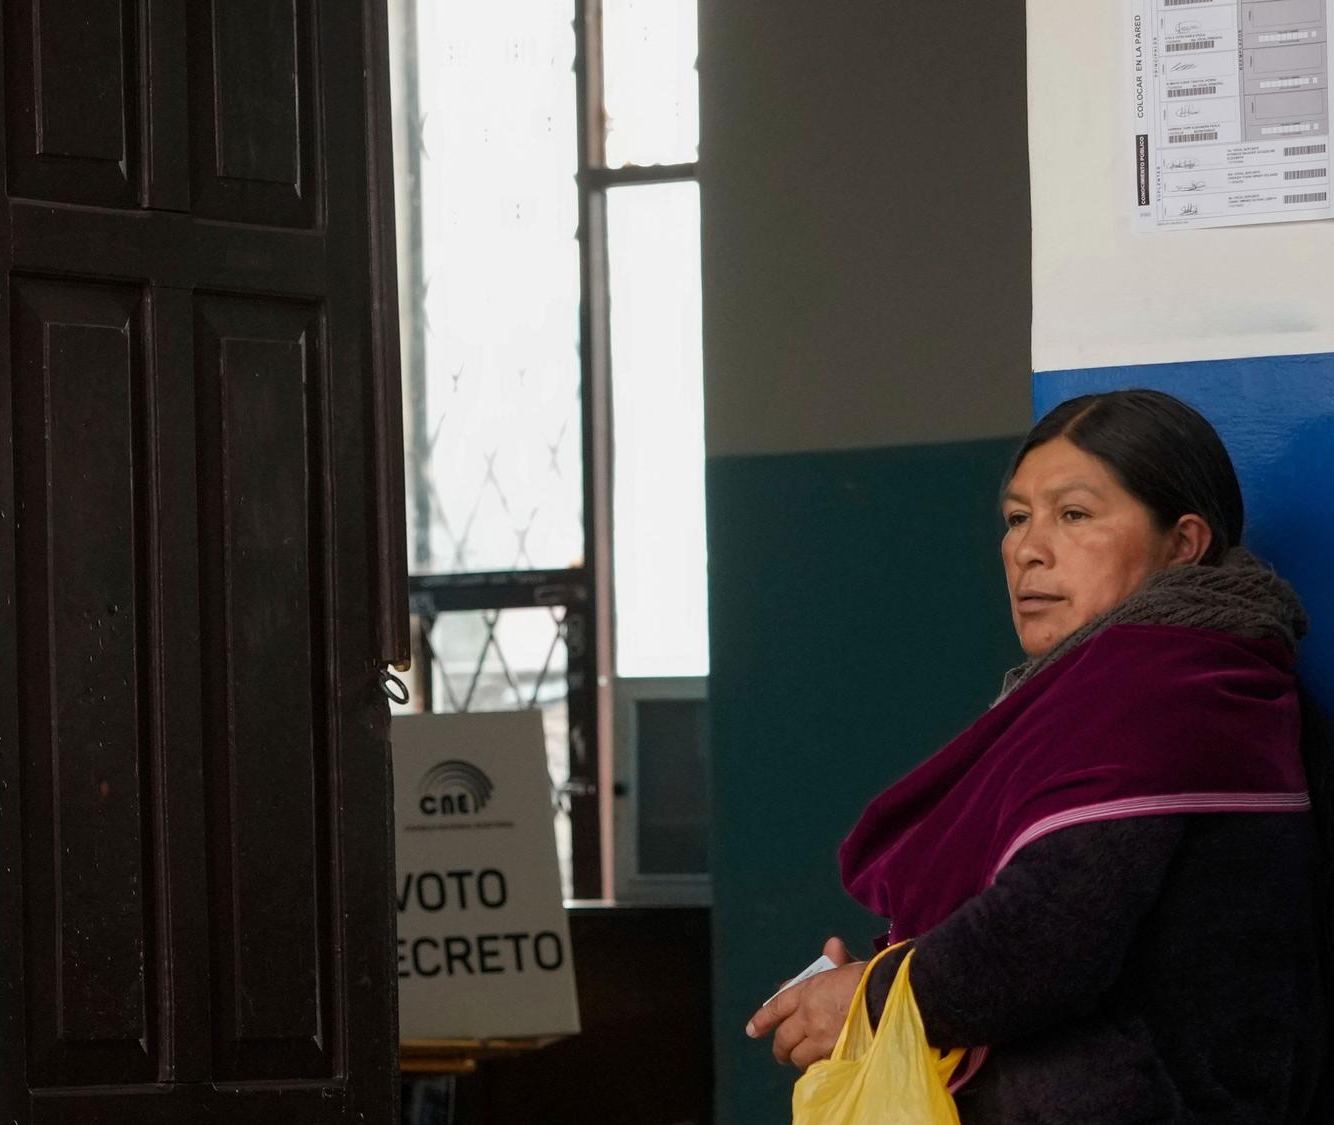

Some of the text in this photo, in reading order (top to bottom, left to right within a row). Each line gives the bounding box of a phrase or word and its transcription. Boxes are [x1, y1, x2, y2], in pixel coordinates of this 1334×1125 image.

[1136, 46, 1142, 57] LA
[1136, 60, 1142, 71] EN
[1136, 75, 1144, 118] COLOCAR
[397, 869, 507, 911] VOTO
[398, 931, 564, 978] CRETO
